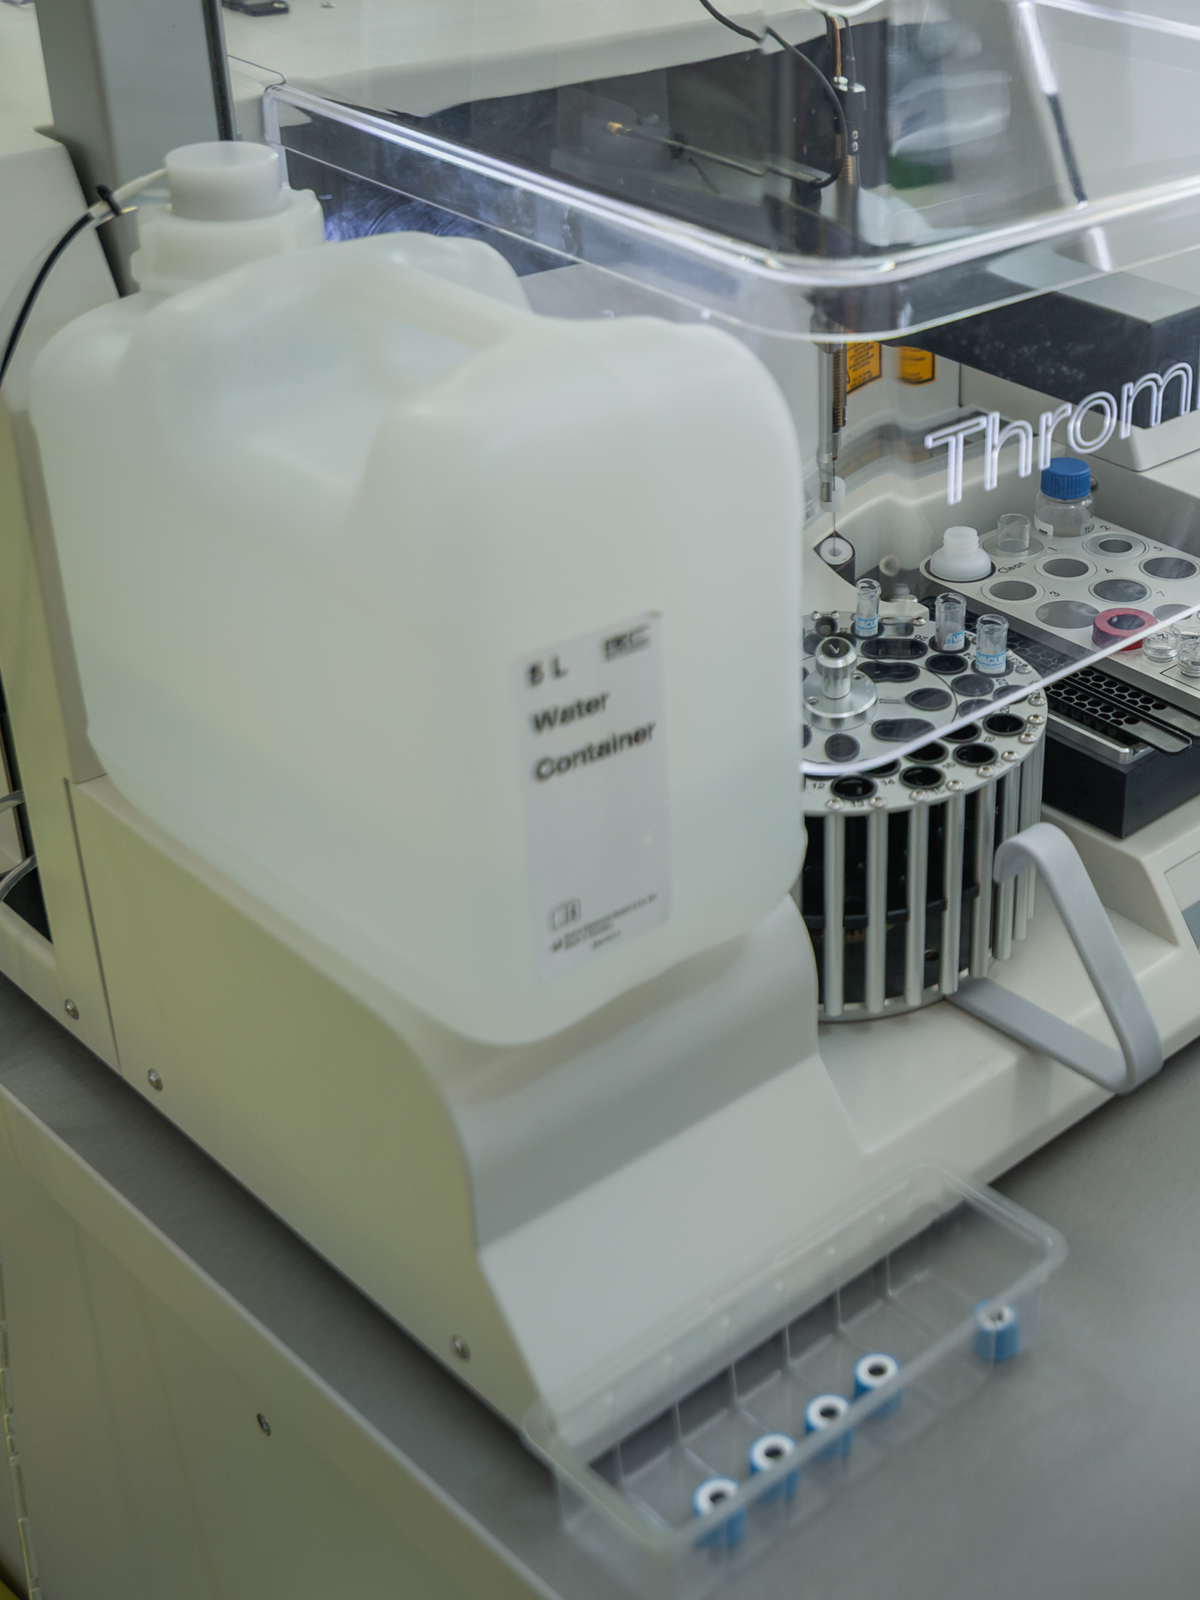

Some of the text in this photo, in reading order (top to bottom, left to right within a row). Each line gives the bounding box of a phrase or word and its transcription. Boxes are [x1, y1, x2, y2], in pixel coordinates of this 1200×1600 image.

[997, 561, 1027, 575] Clean
[532, 693, 609, 733] Water
[535, 723, 656, 782] Container
